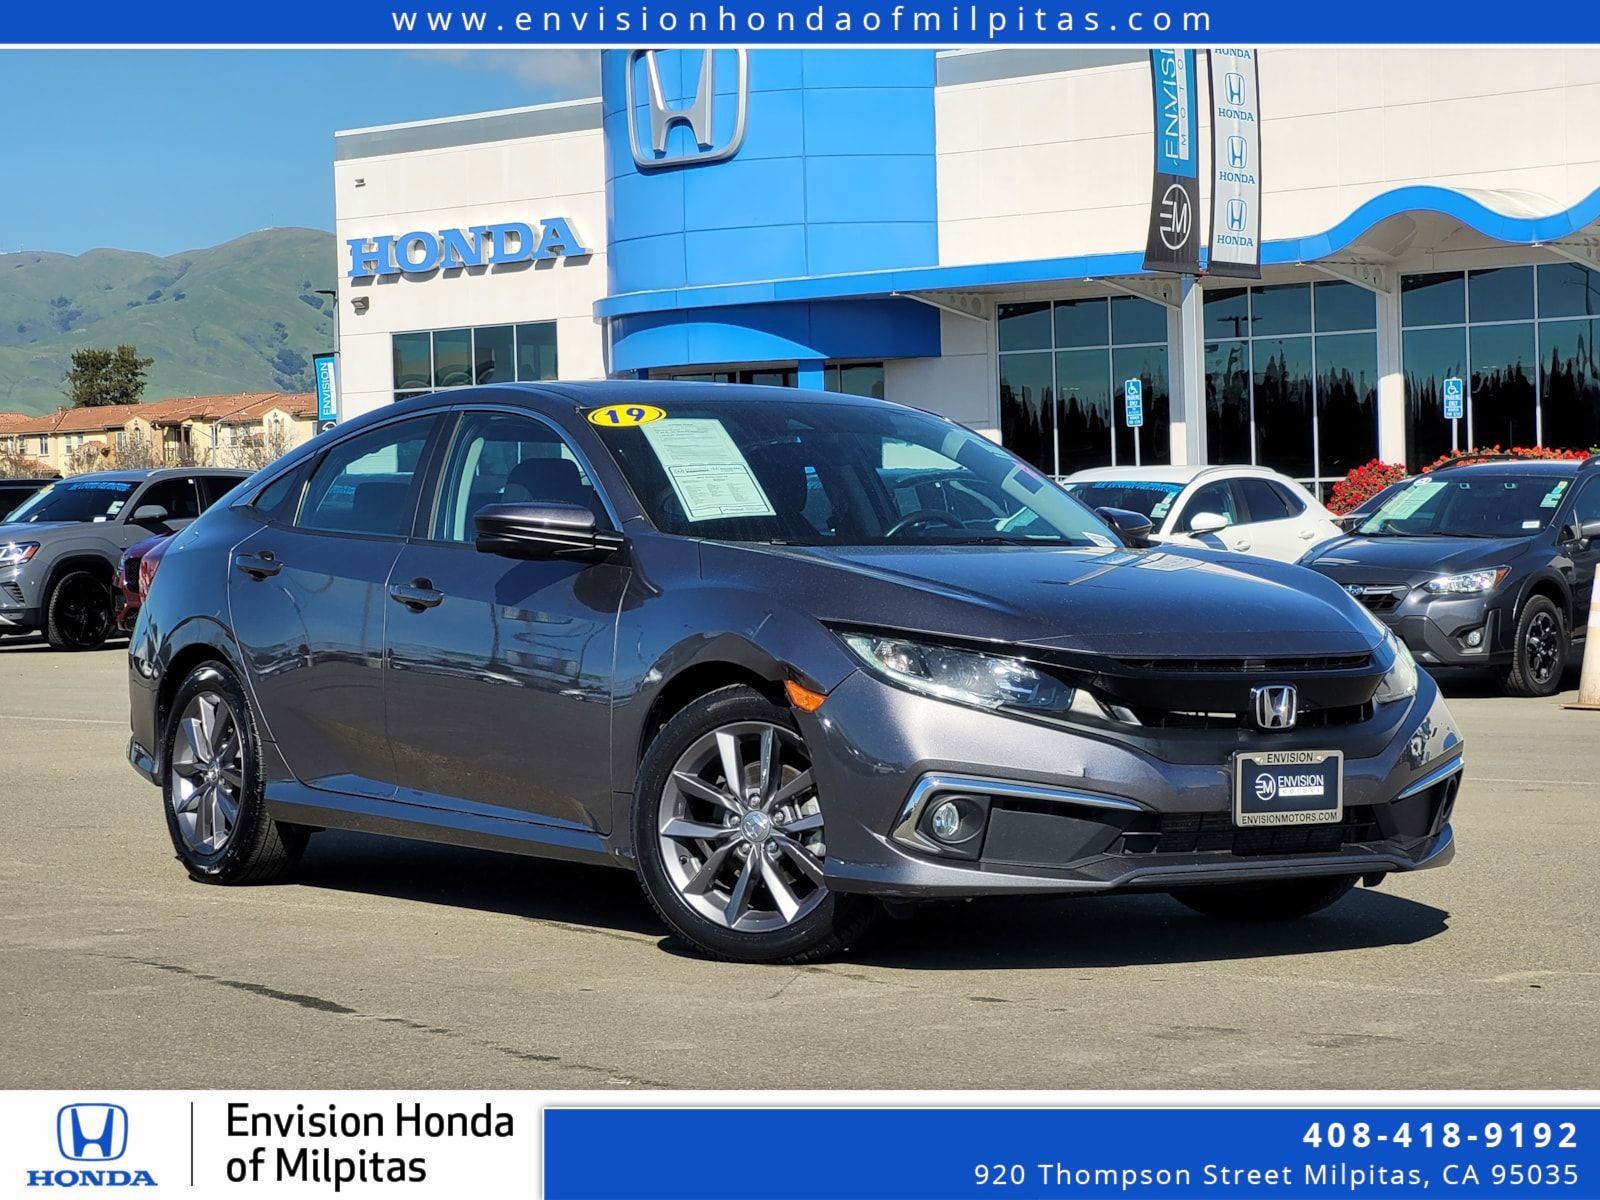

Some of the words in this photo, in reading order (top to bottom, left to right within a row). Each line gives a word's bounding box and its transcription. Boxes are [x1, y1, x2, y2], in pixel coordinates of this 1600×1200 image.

[1218, 108, 1255, 121] HONDA
[1219, 171, 1256, 184] HONDA
[346, 216, 588, 278] HONDA
[1217, 234, 1254, 247] HONDA
[320, 362, 331, 416] ENVISION
[606, 407, 646, 424] 19
[1267, 752, 1314, 763] ENVISION
[1278, 774, 1325, 787] ENVISION
[1242, 811, 1338, 825] ENVISIONMOTORS.COM
